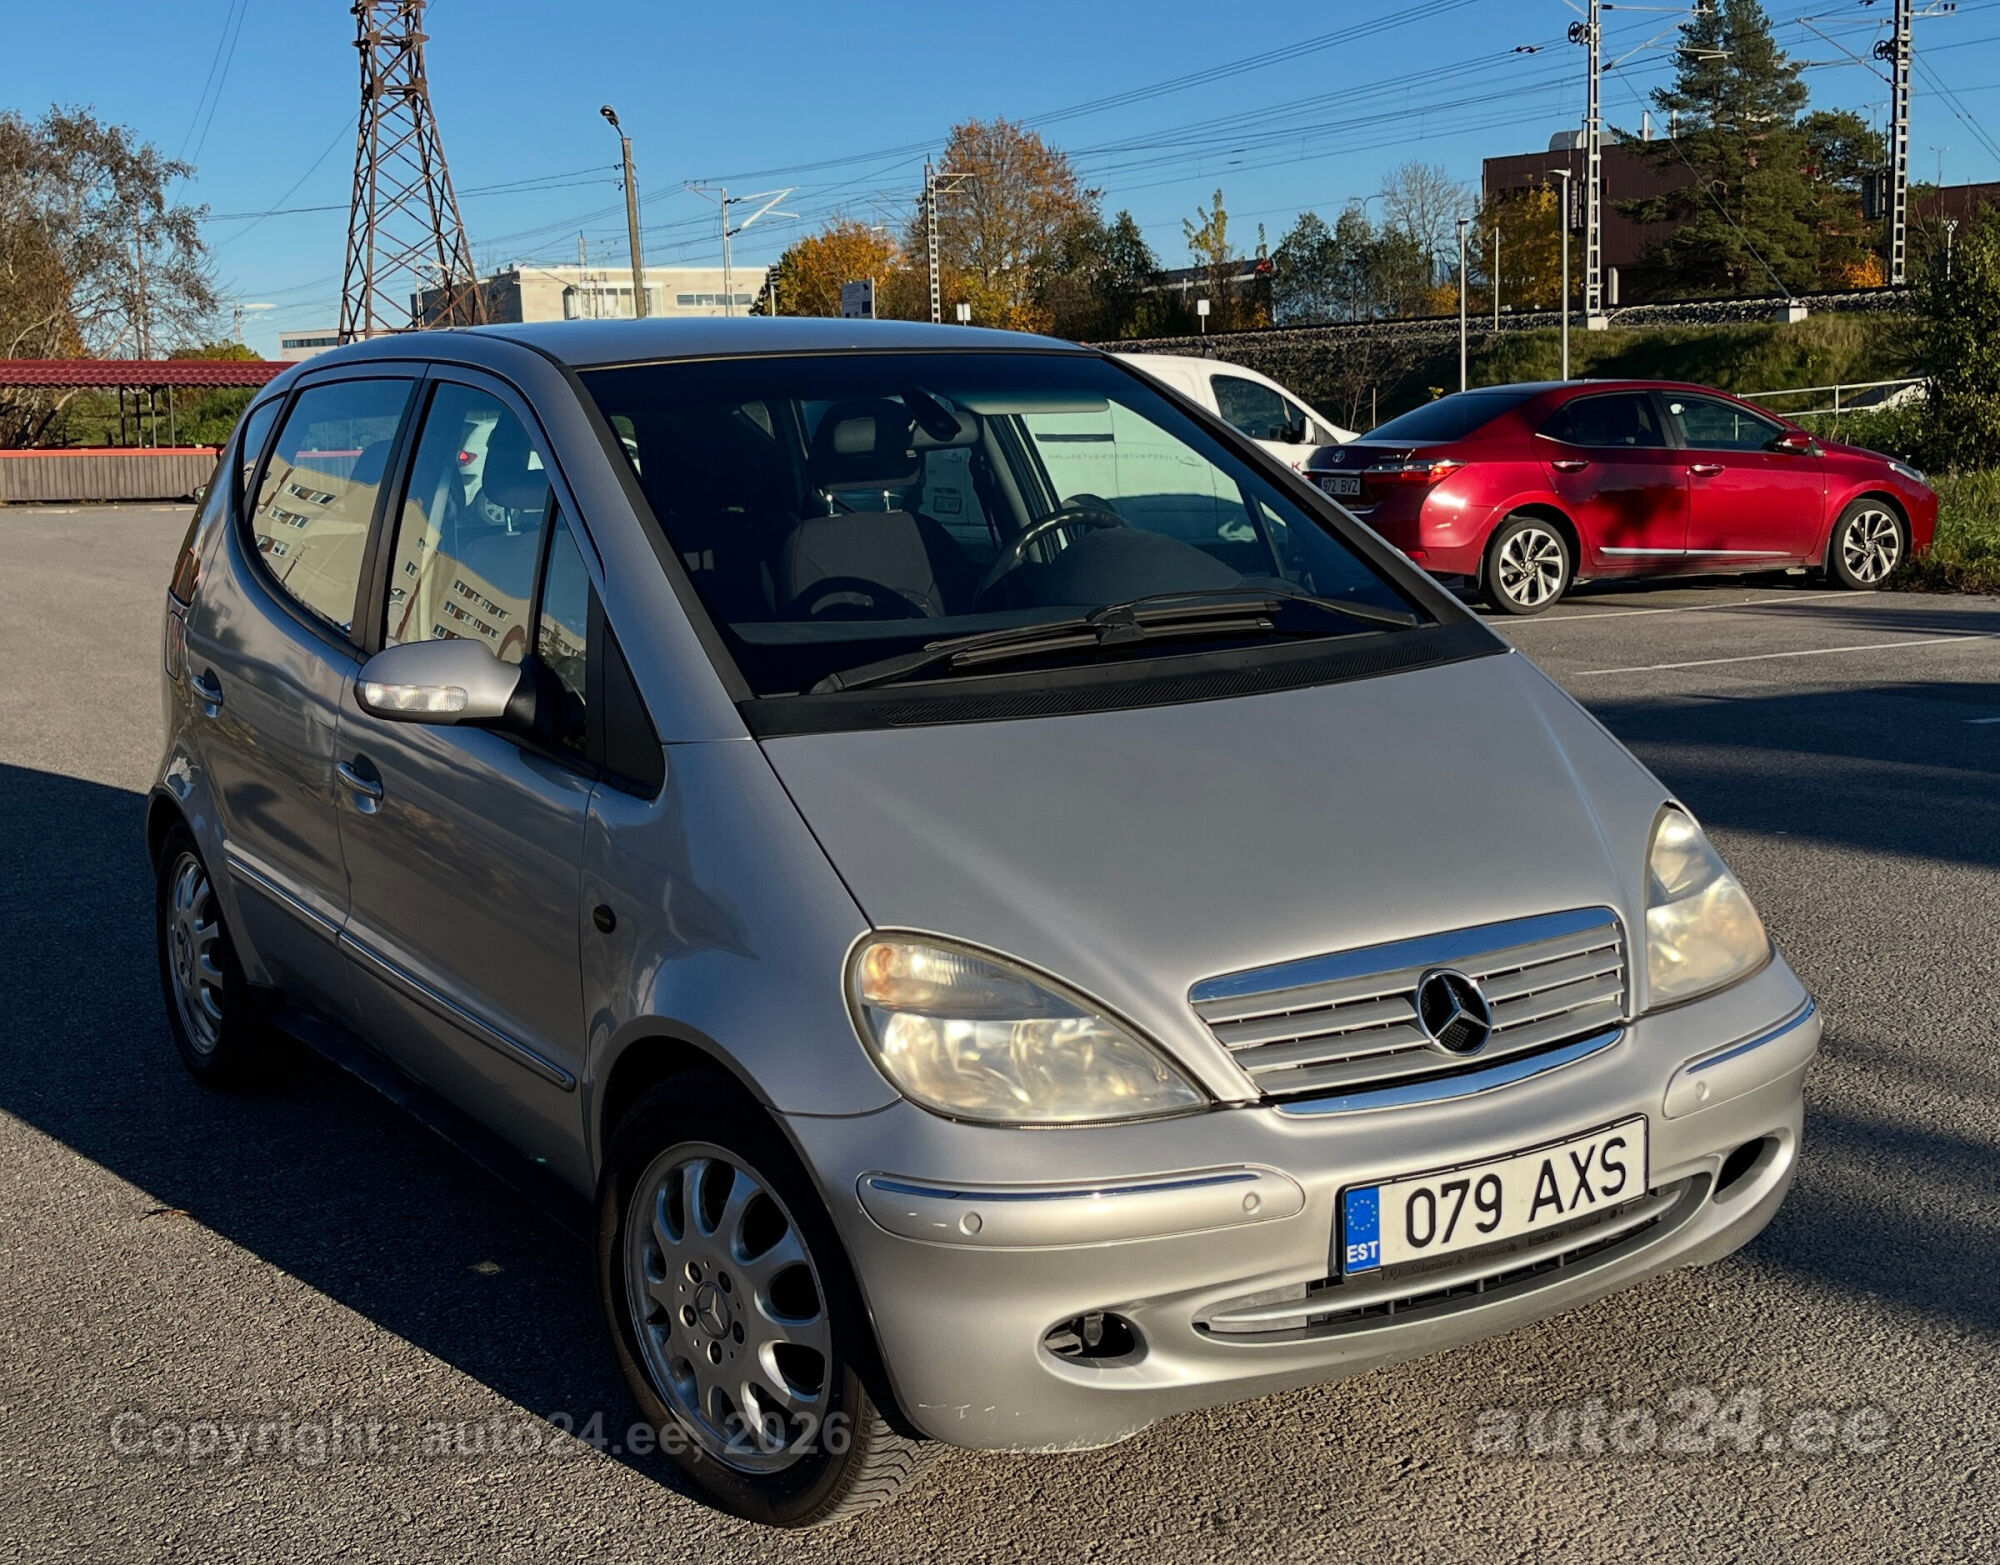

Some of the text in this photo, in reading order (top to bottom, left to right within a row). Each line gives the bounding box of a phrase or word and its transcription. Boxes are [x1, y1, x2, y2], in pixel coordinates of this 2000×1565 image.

[1323, 479, 1358, 493] 972 BVZ
[1406, 1173, 1502, 1249] 079
[1528, 1137, 1626, 1222] AXS
[1346, 1240, 1379, 1264] EST
